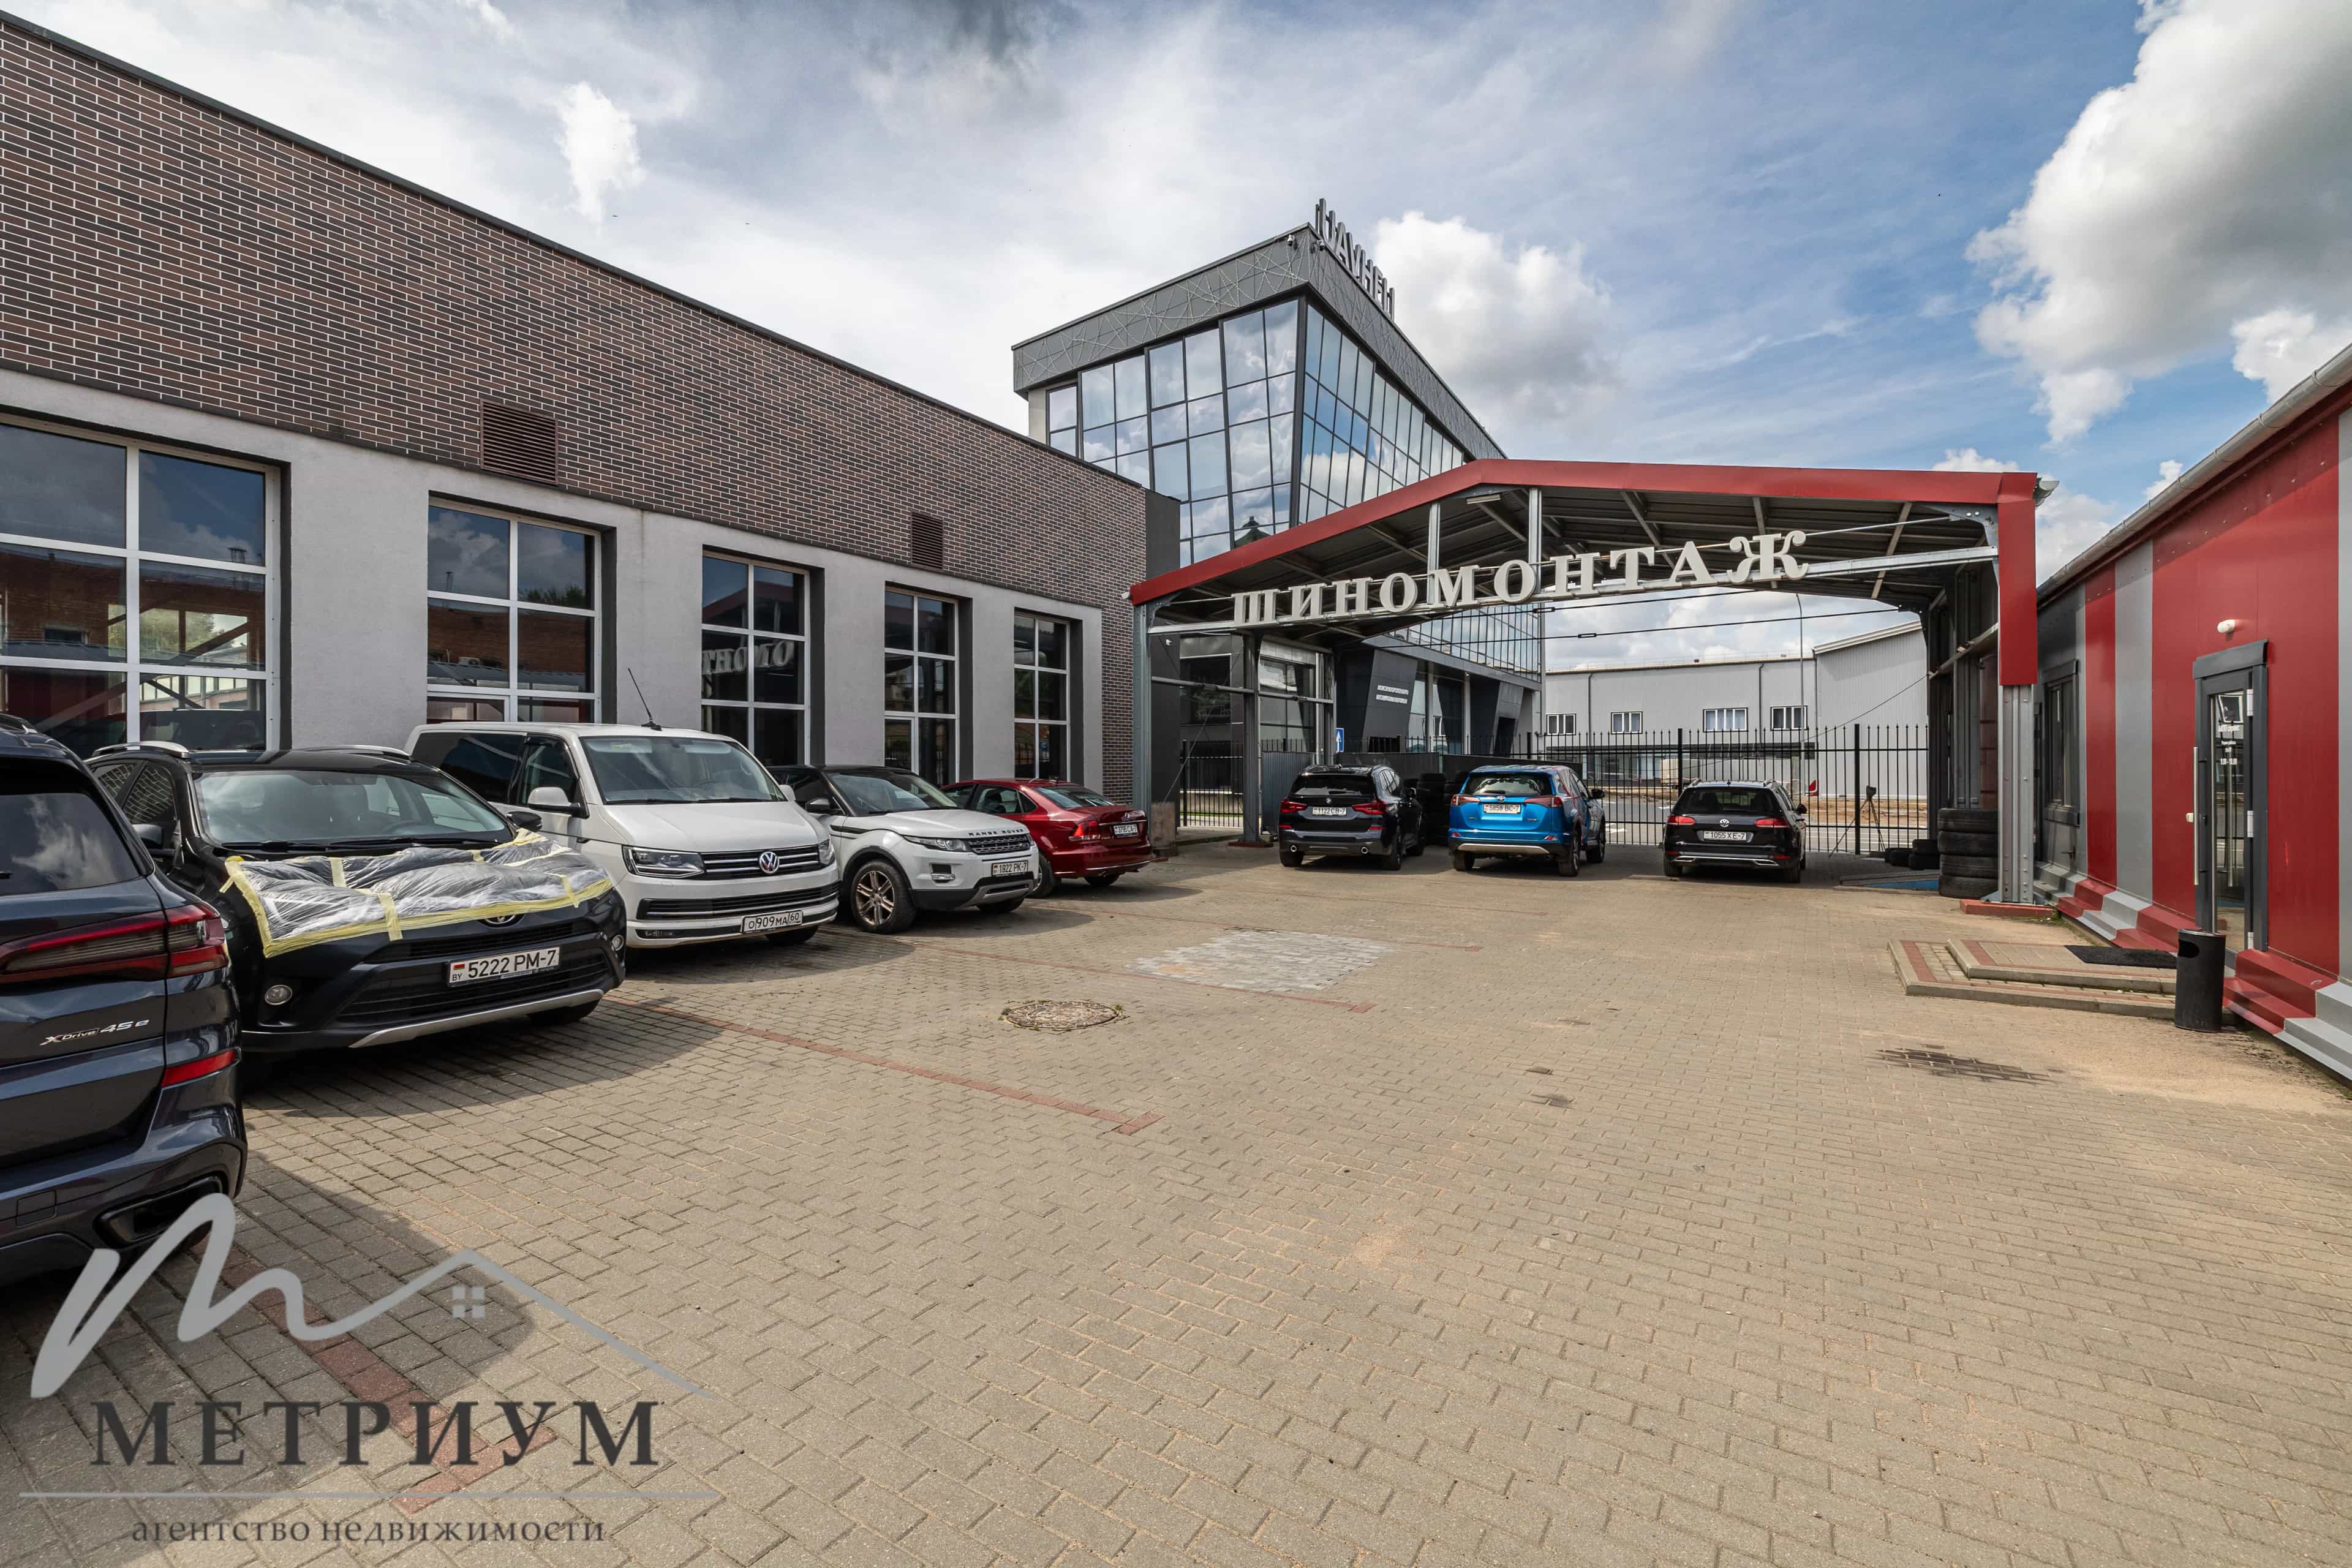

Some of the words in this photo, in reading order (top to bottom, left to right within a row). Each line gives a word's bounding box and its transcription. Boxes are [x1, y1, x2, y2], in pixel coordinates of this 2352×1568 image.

[1231, 530, 1809, 627] ШИНОМОНТАЖ
[999, 863, 1012, 873] 1922
[1013, 862, 1027, 872] PK-7
[790, 912, 799, 921] 60
[468, 957, 510, 978] 5222
[514, 949, 557, 971] PM-7
[452, 973, 462, 981] BY
